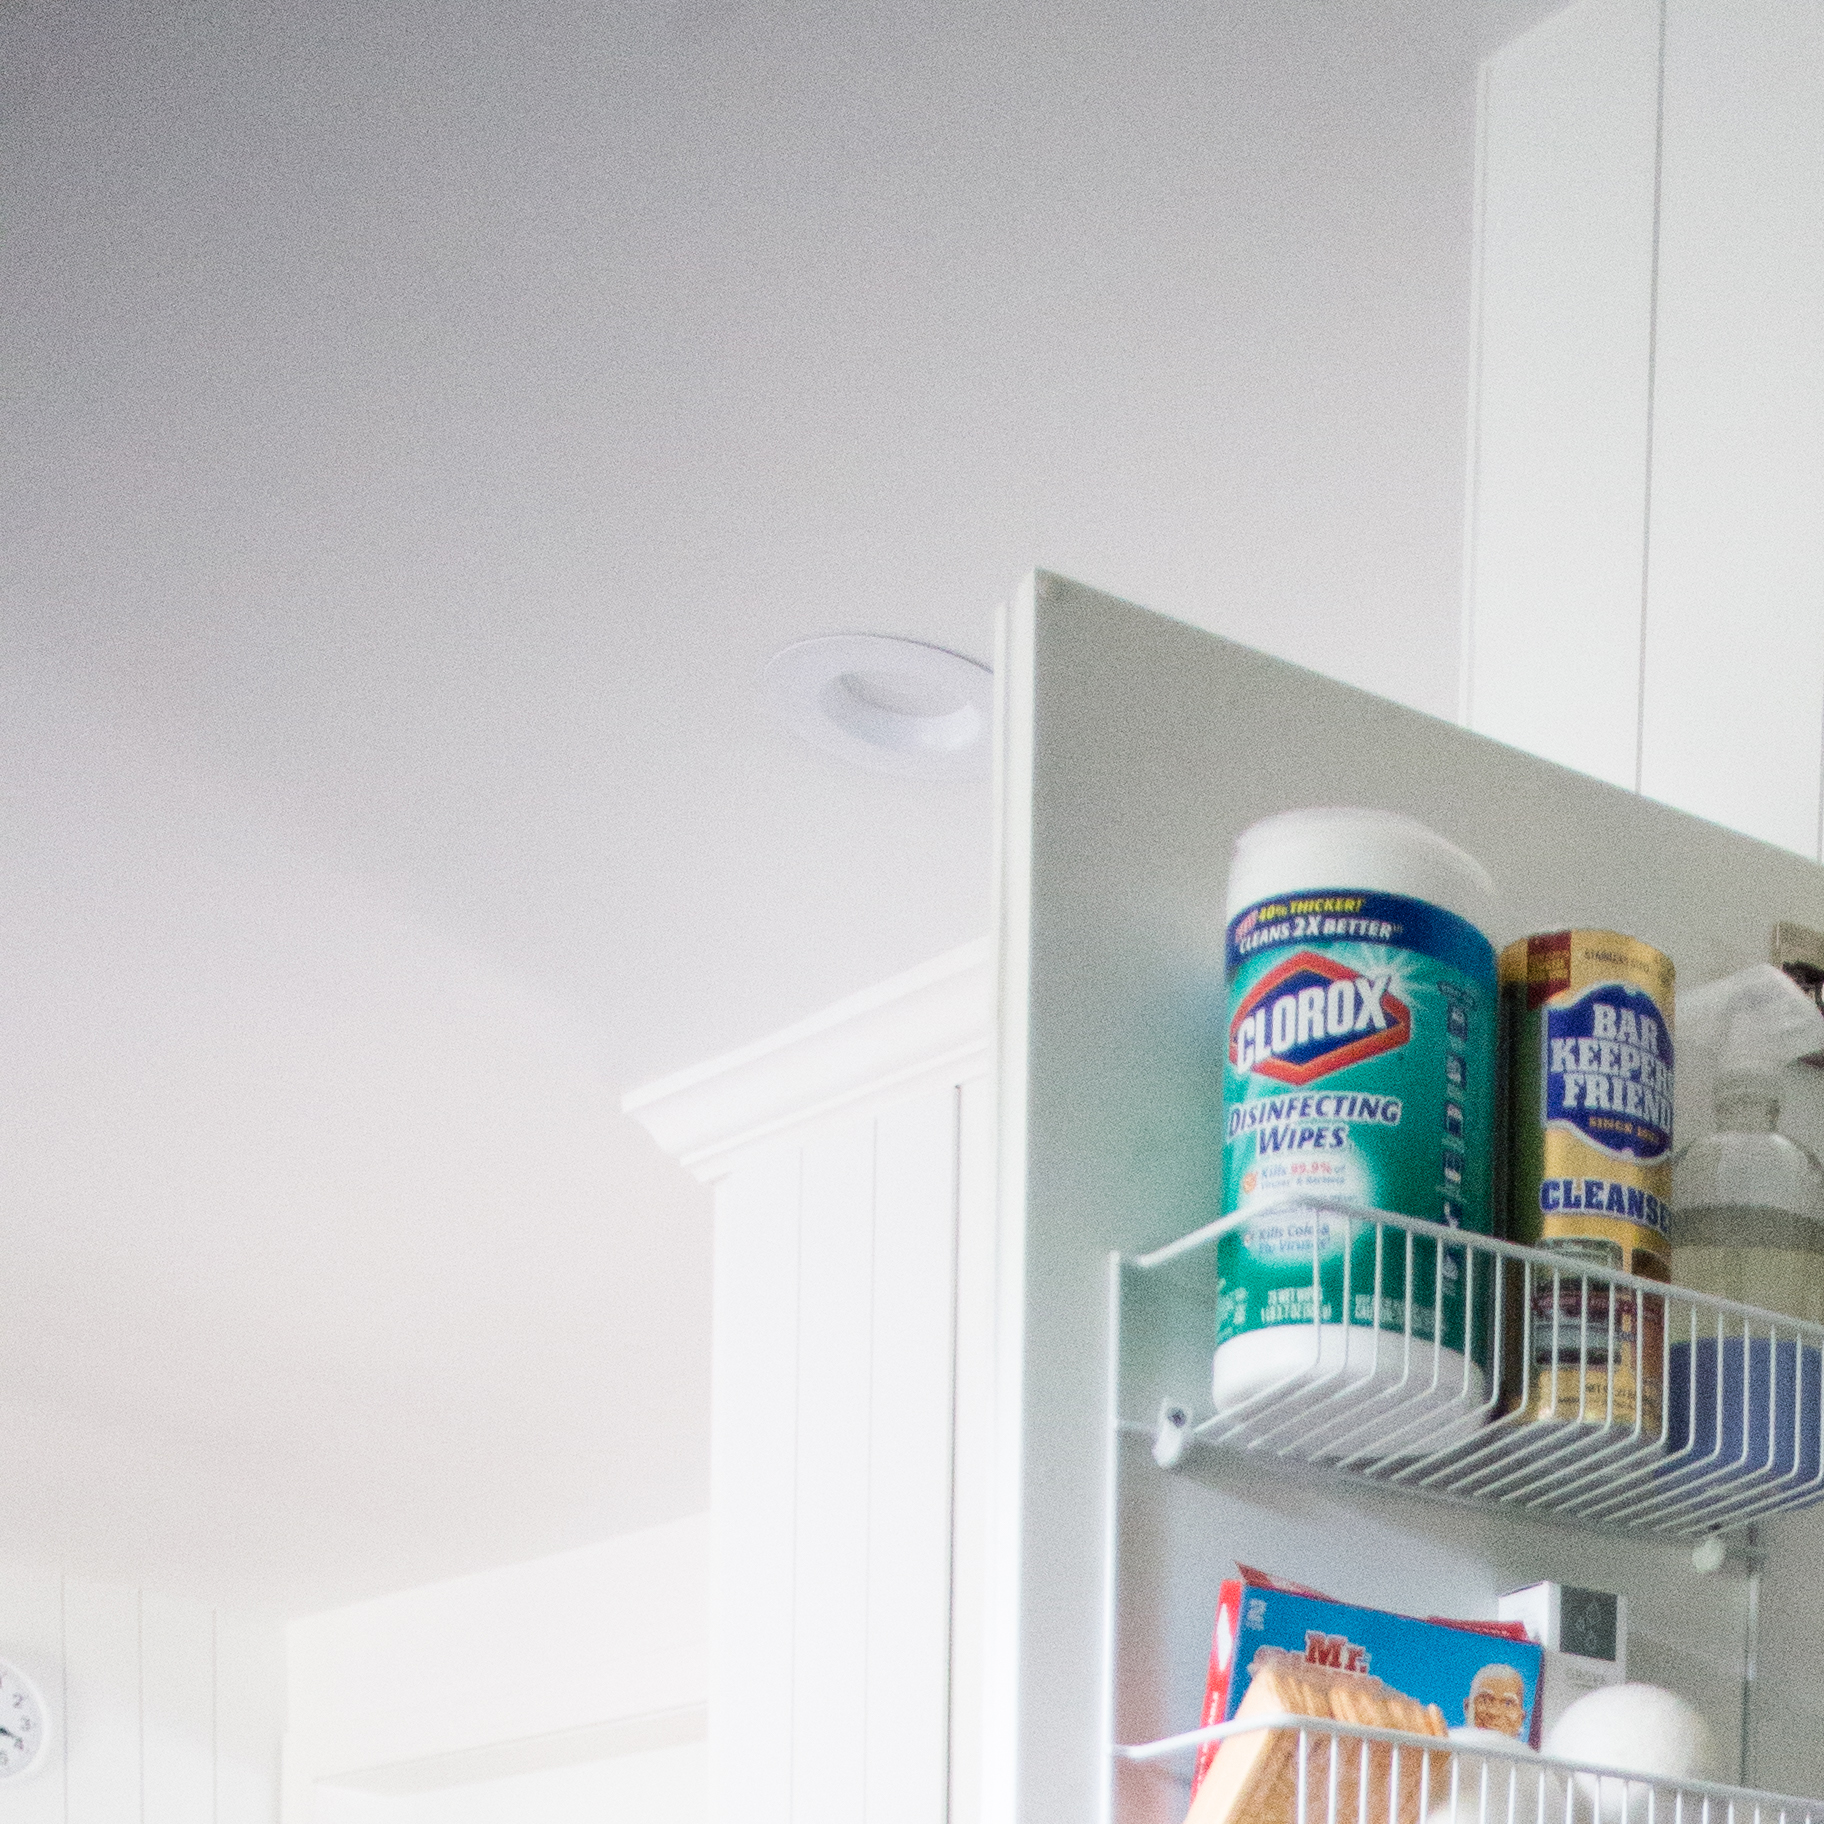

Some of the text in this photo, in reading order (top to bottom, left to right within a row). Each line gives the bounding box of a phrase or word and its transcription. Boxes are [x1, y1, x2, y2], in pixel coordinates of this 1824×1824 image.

[1239, 923, 1289, 955] CLEANS
[1293, 915, 1322, 938] 2X
[1236, 975, 1392, 1074] CLOROX
[1593, 1003, 1659, 1054] BAR
[1228, 1093, 1402, 1138] DISINFECTING
[1258, 1125, 1347, 1156] WIPES
[1303, 1629, 1371, 1677] Mr.
[13, 1692, 24, 1709] 2
[20, 1715, 31, 1732] 3
